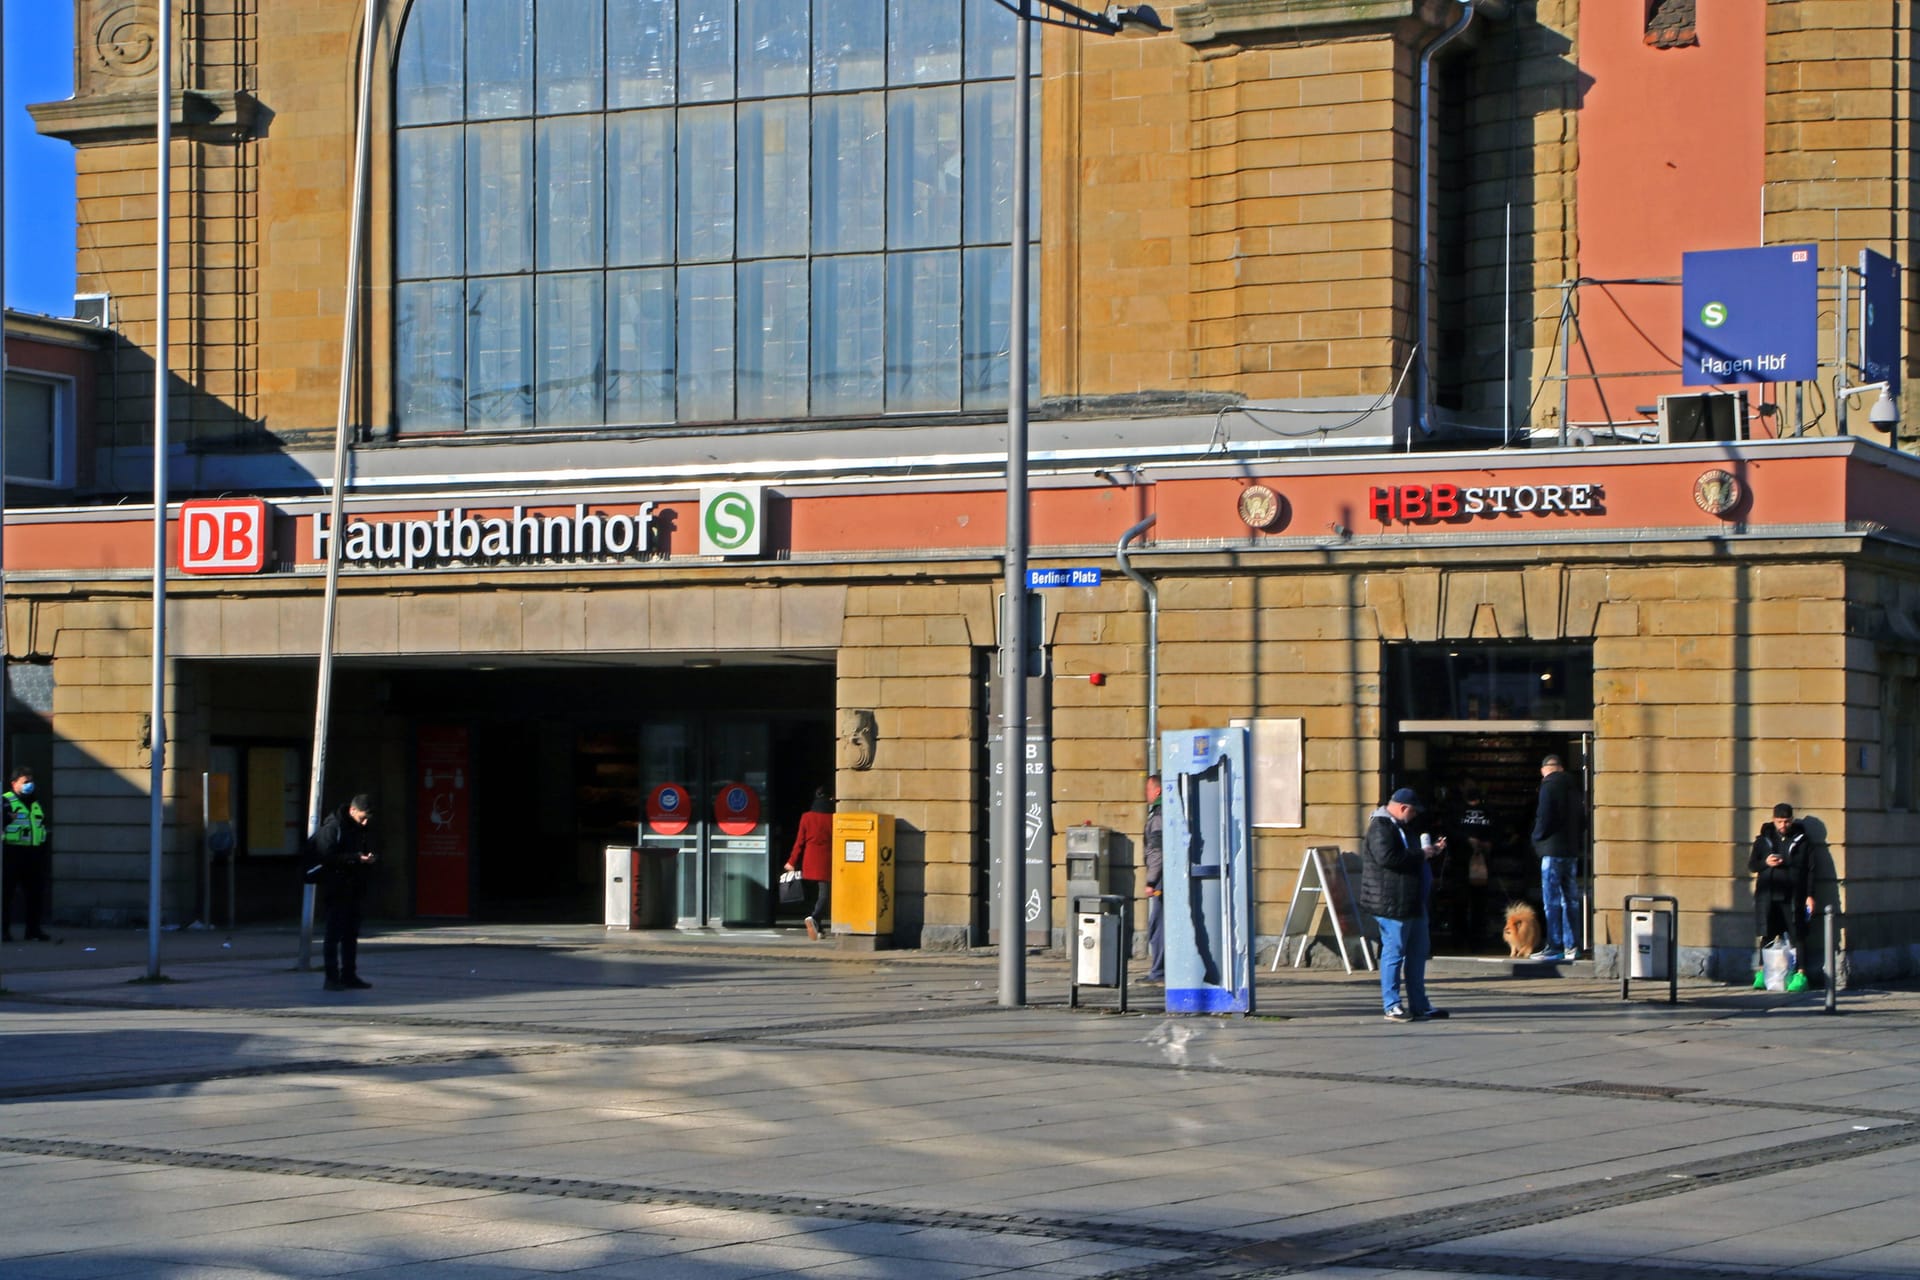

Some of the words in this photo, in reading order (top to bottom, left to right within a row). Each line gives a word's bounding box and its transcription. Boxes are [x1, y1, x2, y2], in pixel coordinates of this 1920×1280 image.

[1793, 252, 1806, 261] DB
[1704, 303, 1724, 326] S
[1701, 357, 1752, 375] Hagen
[1757, 353, 1787, 371] Hbf
[1369, 483, 1459, 520] HBB
[1464, 483, 1592, 513] STORE
[713, 496, 748, 545] S
[188, 511, 253, 562] DB
[313, 501, 653, 569] Hauptbahnhof
[1031, 571, 1071, 585] Berliner
[1072, 570, 1097, 584] Platz
[995, 763, 1044, 774] SRE
